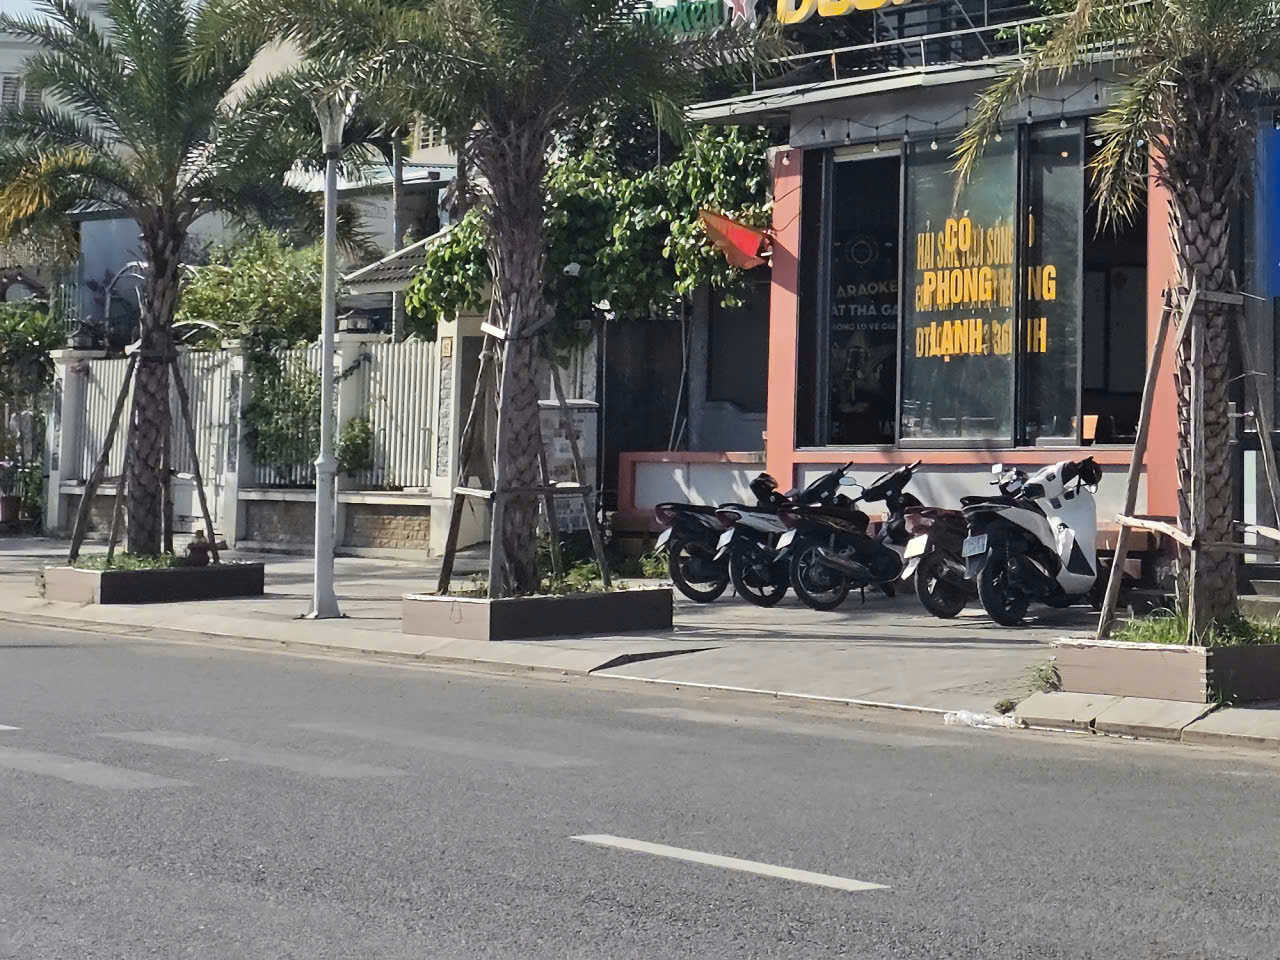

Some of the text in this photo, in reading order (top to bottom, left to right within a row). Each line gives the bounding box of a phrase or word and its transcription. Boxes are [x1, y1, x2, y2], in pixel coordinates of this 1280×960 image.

[945, 209, 972, 252] CÓ
[836, 280, 898, 296] ARAOKE
[929, 318, 983, 363] LẠNH
